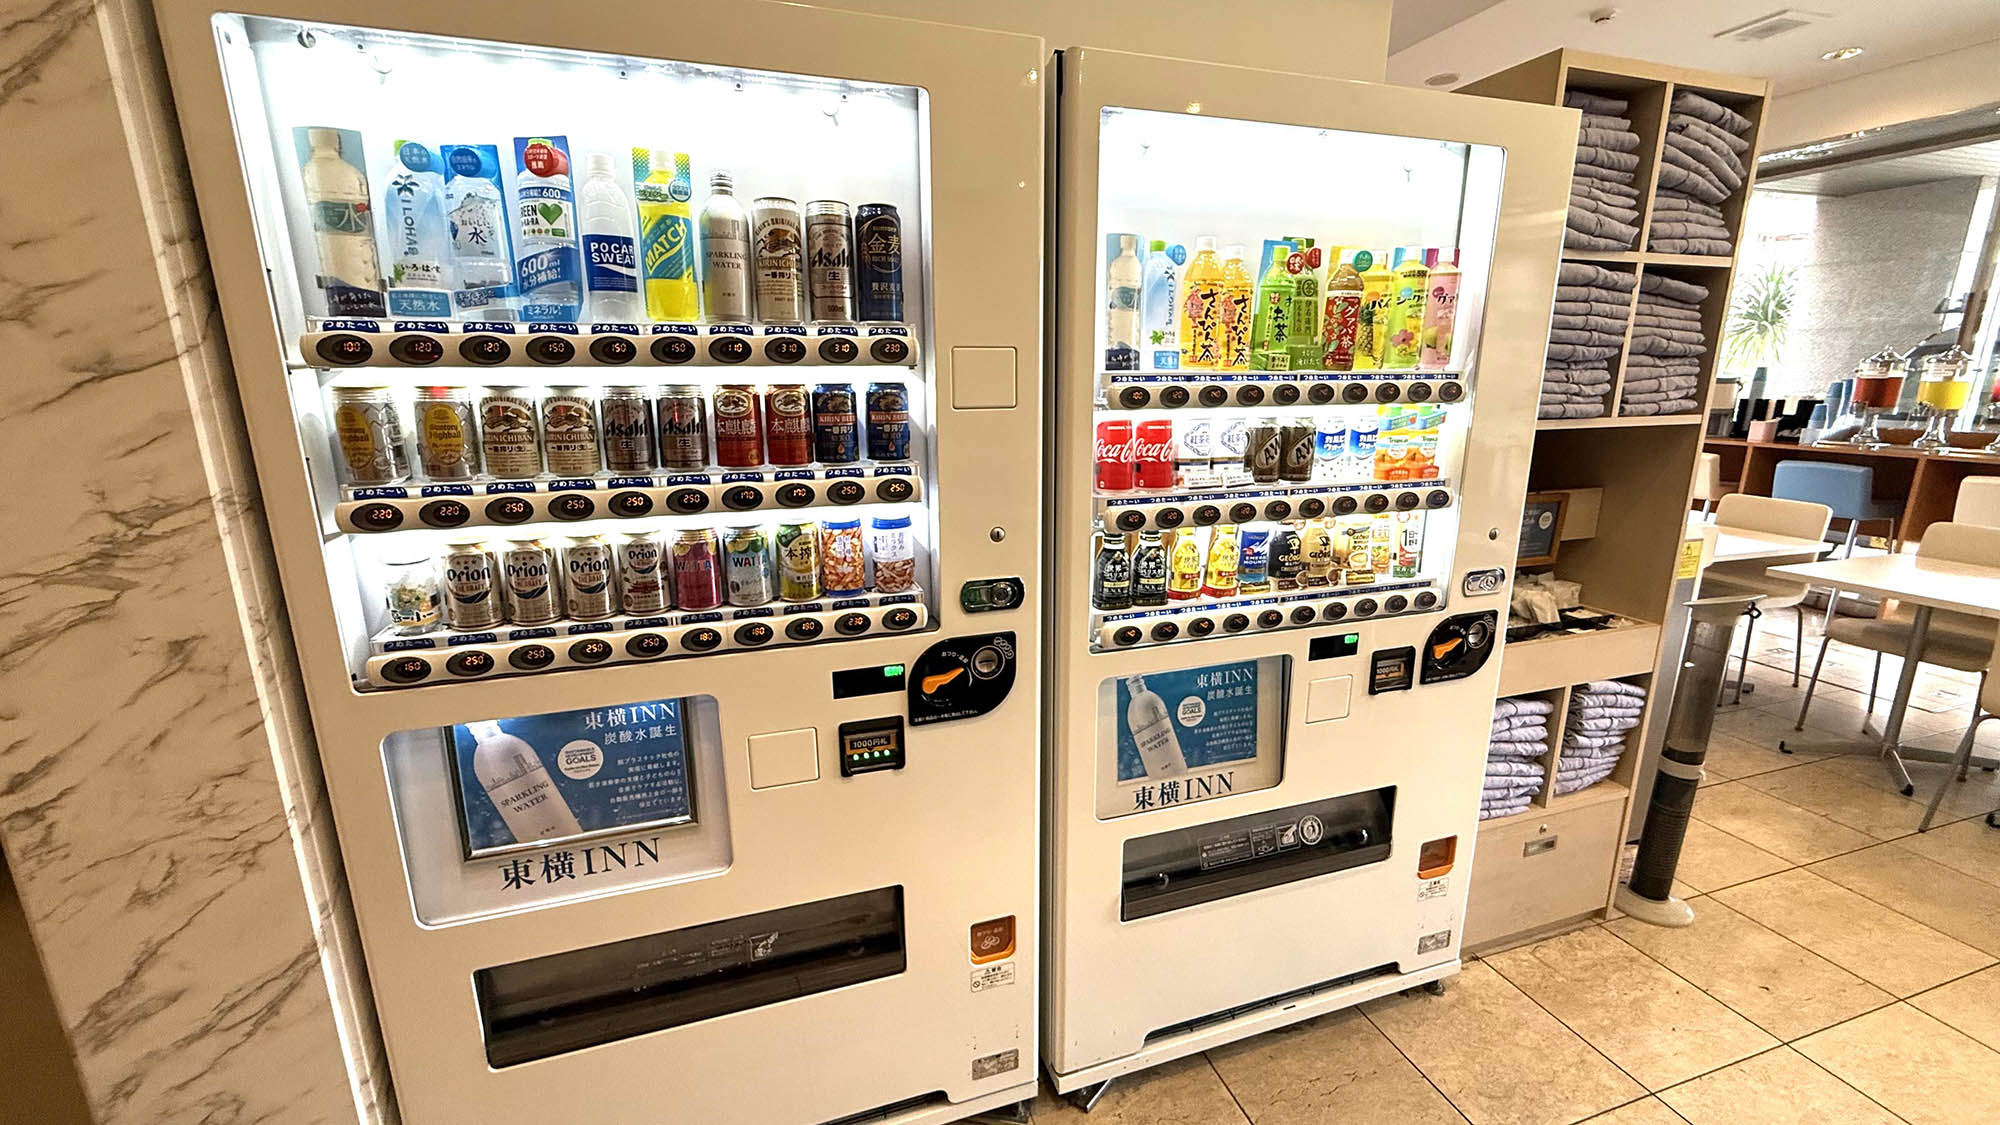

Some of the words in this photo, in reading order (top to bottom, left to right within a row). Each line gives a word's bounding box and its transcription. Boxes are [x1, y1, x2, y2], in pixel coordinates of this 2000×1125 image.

[542, 188, 561, 199] 600
[469, 226, 488, 245] 水
[645, 219, 688, 276] MATCH
[868, 233, 900, 255] 金麦
[591, 252, 635, 265] SWEAT
[712, 260, 741, 270] WATER
[828, 271, 841, 281] 生
[1198, 288, 1219, 363] さんぴん茶
[1231, 294, 1249, 366] さんぴん茶
[1342, 304, 1359, 349] グアバ茶
[343, 341, 361, 352] 100
[415, 342, 432, 352] 120
[484, 342, 500, 352] 120
[549, 343, 565, 353] 150
[611, 343, 627, 353] 150
[671, 343, 686, 353] 150
[728, 344, 743, 353] 110
[781, 344, 797, 353] 310
[834, 344, 850, 353] 310
[884, 344, 900, 353] 230
[840, 485, 857, 495] 250
[889, 483, 905, 493] 250
[566, 499, 585, 509] 250
[626, 496, 644, 507] 250
[682, 493, 700, 504] 250
[439, 506, 459, 516] 220
[504, 503, 524, 513] 250
[371, 509, 393, 520] 220
[628, 548, 658, 560] Orion
[507, 562, 548, 577] Orion
[569, 557, 610, 573] Orion
[446, 566, 491, 582] Orion
[642, 637, 659, 648] 250
[585, 643, 603, 654] 250
[526, 649, 545, 660] 250
[404, 661, 421, 672] 160
[465, 655, 484, 667] 250
[1196, 667, 1254, 689] 東横INN
[584, 702, 676, 731] 東横INN
[604, 724, 677, 745] 炭酸水誕生
[853, 737, 888, 749] 1000円札
[565, 754, 597, 765] GOALS
[500, 781, 550, 807] SPARKLING
[1131, 771, 1235, 811] 東横INN
[513, 794, 549, 813] WATER
[498, 837, 662, 891] 東横INN
